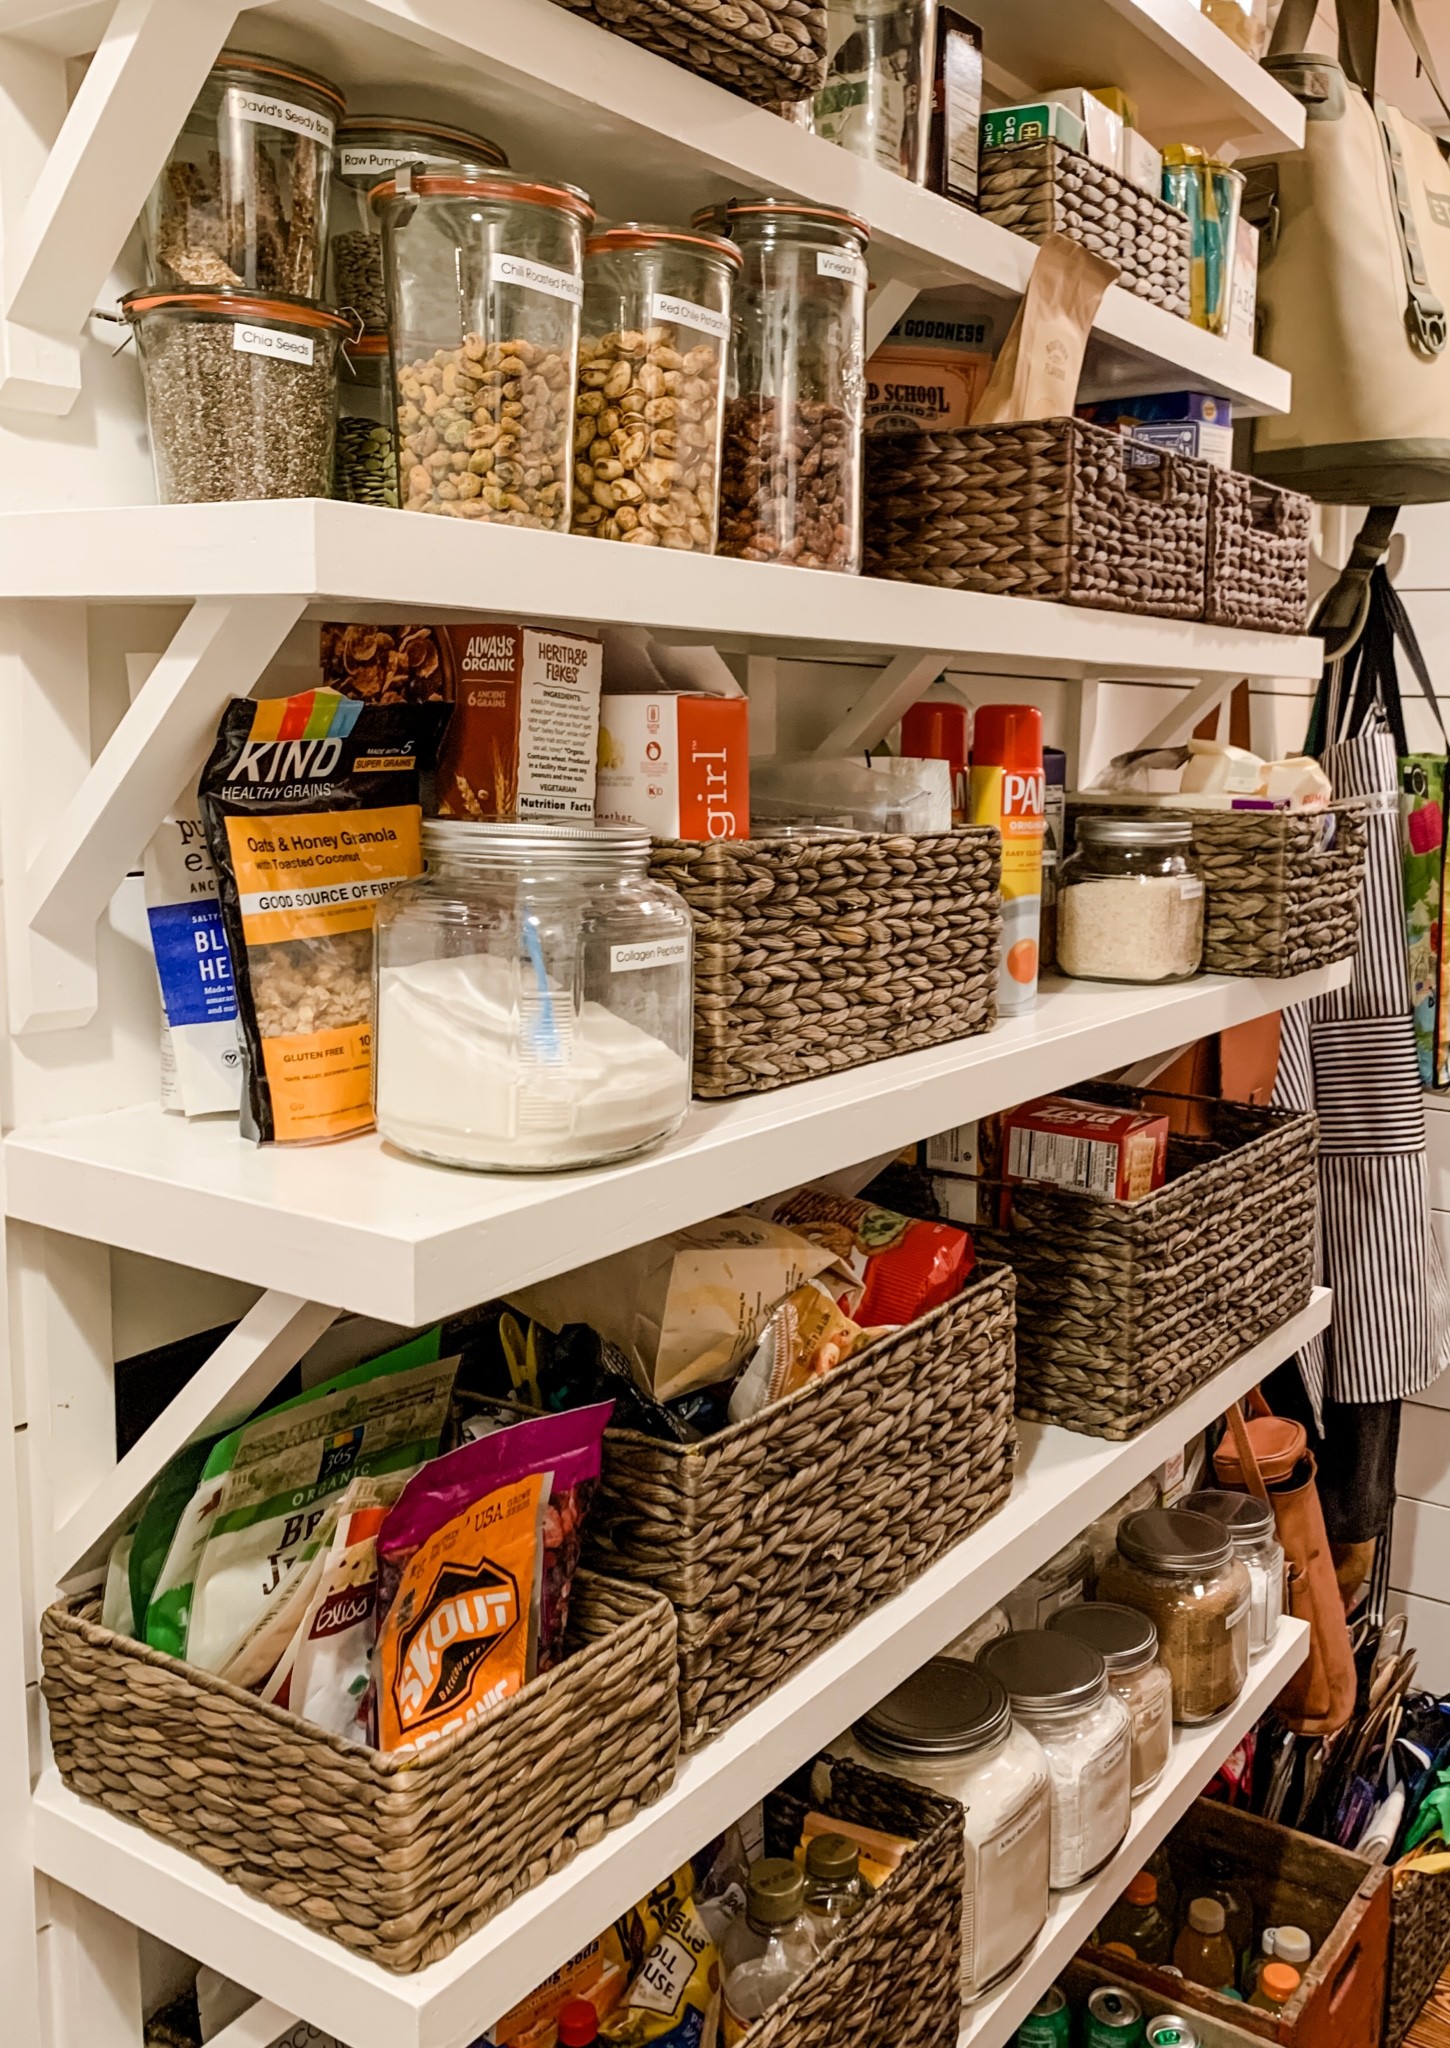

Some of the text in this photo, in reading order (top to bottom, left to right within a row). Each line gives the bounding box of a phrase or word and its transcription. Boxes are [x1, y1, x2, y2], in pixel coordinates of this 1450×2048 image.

[285, 108, 315, 131] Seedy
[344, 154, 367, 166] Raw
[526, 267, 559, 289] Roasted
[660, 300, 680, 315] Red
[904, 319, 986, 343] GOODNESS
[242, 330, 309, 356] Chia Seeds
[884, 383, 951, 414] SCHOOL
[466, 635, 515, 658] ALWAYS
[462, 658, 515, 672] ORGANIC
[467, 691, 477, 707] 6
[477, 690, 506, 699] ANCIENT
[477, 699, 506, 708] GRAINS
[401, 740, 415, 755] 5
[226, 737, 343, 783] KIND
[355, 758, 382, 769] SUPER
[221, 787, 284, 800] HEALTHY
[540, 783, 577, 793] VEGETARIAN
[521, 797, 592, 812] Nutrition Facts
[247, 827, 398, 853] Oats & Honey Granola
[256, 851, 361, 870] with Toasted Coconut
[259, 880, 400, 910] GOOD SOURCE OF FIBE
[616, 944, 685, 963] Collagen Peptides
[204, 985, 225, 995] Made
[208, 1004, 222, 1015] and
[283, 1050, 324, 1063] GLUTEN
[325, 1046, 345, 1058] FREE
[1030, 1105, 1122, 1125] Zesta
[324, 1448, 355, 1474] 365
[291, 1462, 371, 1507] ORGANIC
[475, 1502, 504, 1533] USA
[315, 1597, 367, 1633] bliss
[400, 1591, 512, 1721] SKOUT
[437, 1643, 488, 1702] BACKCOUNTRY
